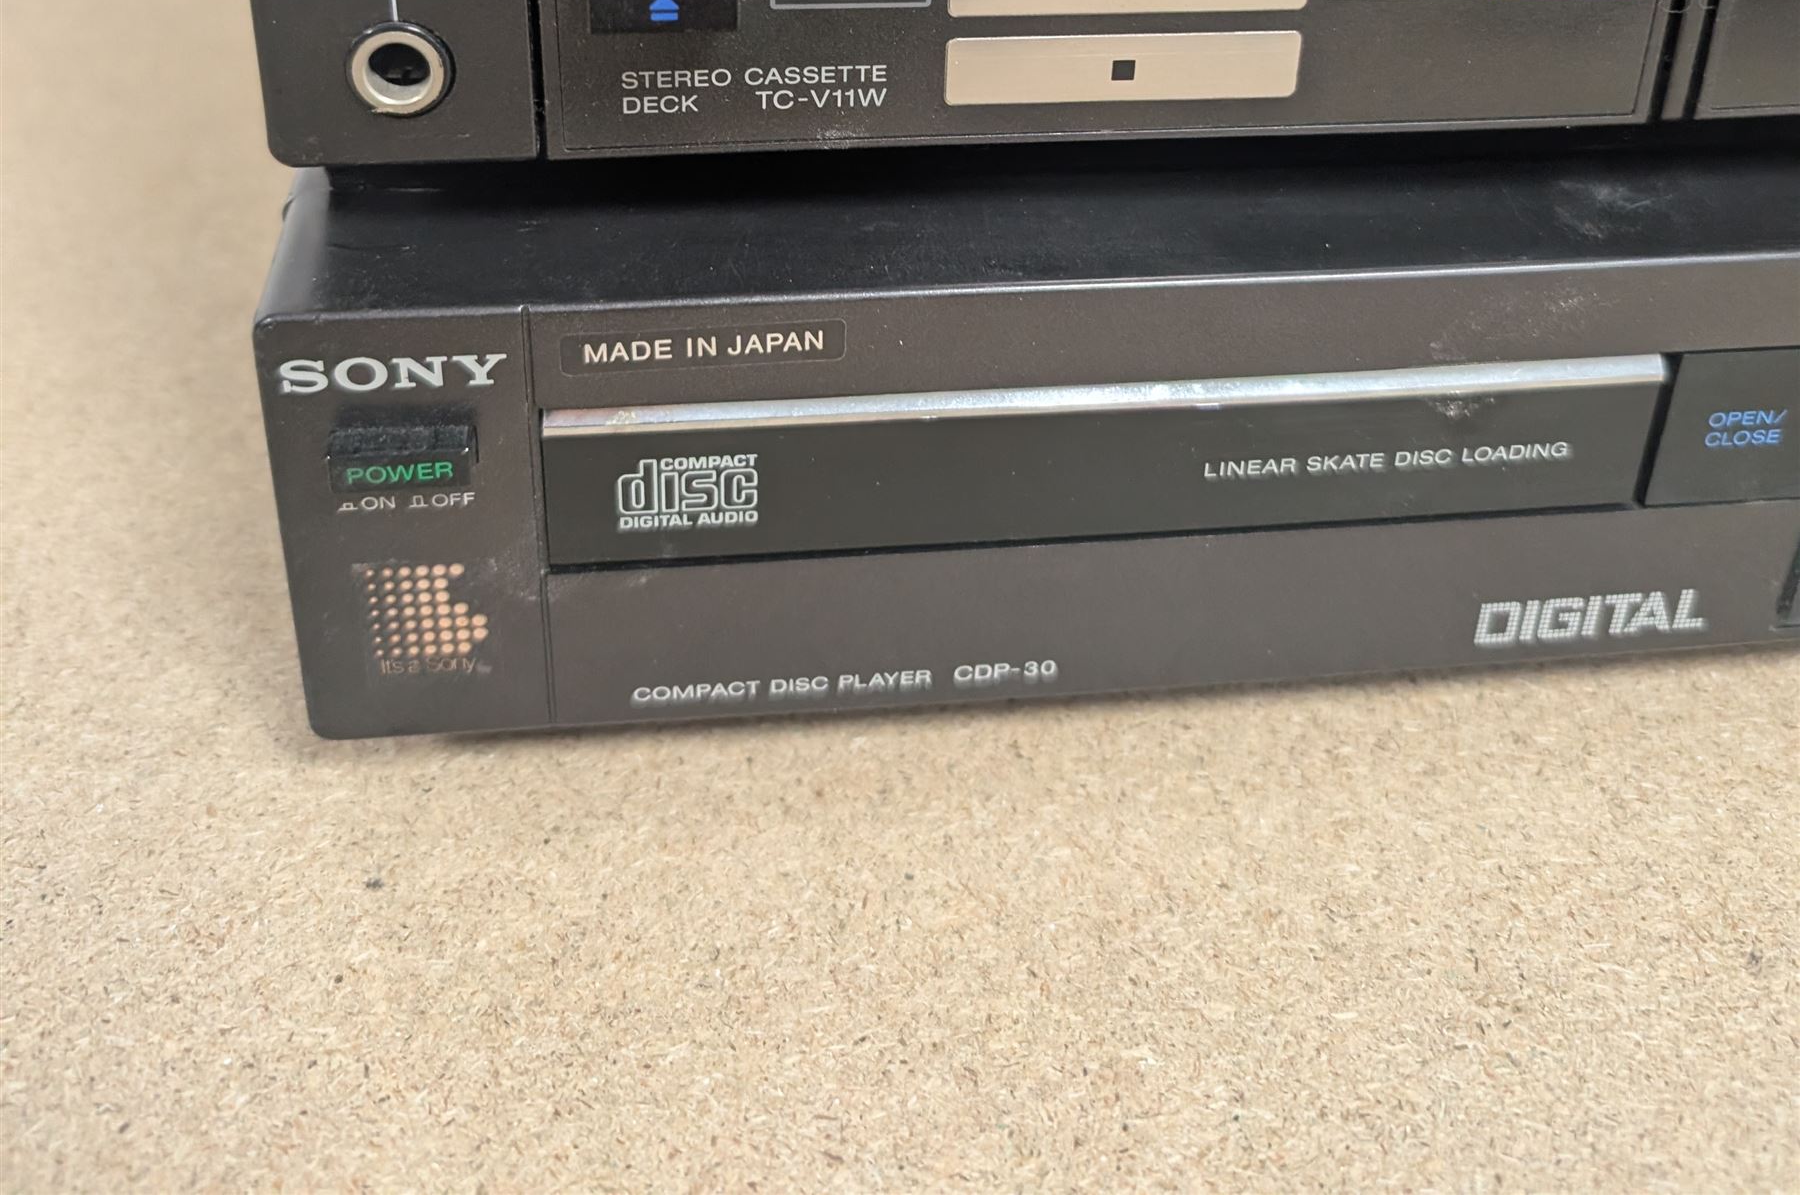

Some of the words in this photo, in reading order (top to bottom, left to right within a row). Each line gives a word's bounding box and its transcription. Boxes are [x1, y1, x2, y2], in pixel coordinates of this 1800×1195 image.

[621, 68, 732, 89] STEREO
[744, 65, 887, 85] CASSETTE
[622, 94, 699, 114] DECK
[755, 88, 887, 111] TC-V11W
[584, 339, 673, 364] MADE
[687, 336, 717, 358] IN
[727, 330, 824, 355] JAPAN
[279, 353, 507, 393] SONY
[1704, 429, 1782, 447] CLOSE
[660, 454, 758, 469] COMPACT
[1203, 458, 1298, 478] LINEAR
[1306, 453, 1386, 473] SKATE
[1394, 449, 1453, 468] DISC
[1461, 442, 1569, 464] LOADING
[346, 461, 454, 485] POWER
[361, 496, 396, 511] ON
[432, 492, 475, 507] OFF
[619, 513, 692, 529] DIGITAL
[697, 510, 758, 525] AUDIO
[1474, 589, 1704, 646] DIGITAL
[632, 680, 761, 702] COMPACT
[769, 675, 829, 695] DISC
[837, 669, 932, 691] PLAYER
[953, 660, 1058, 682] CDP-30
